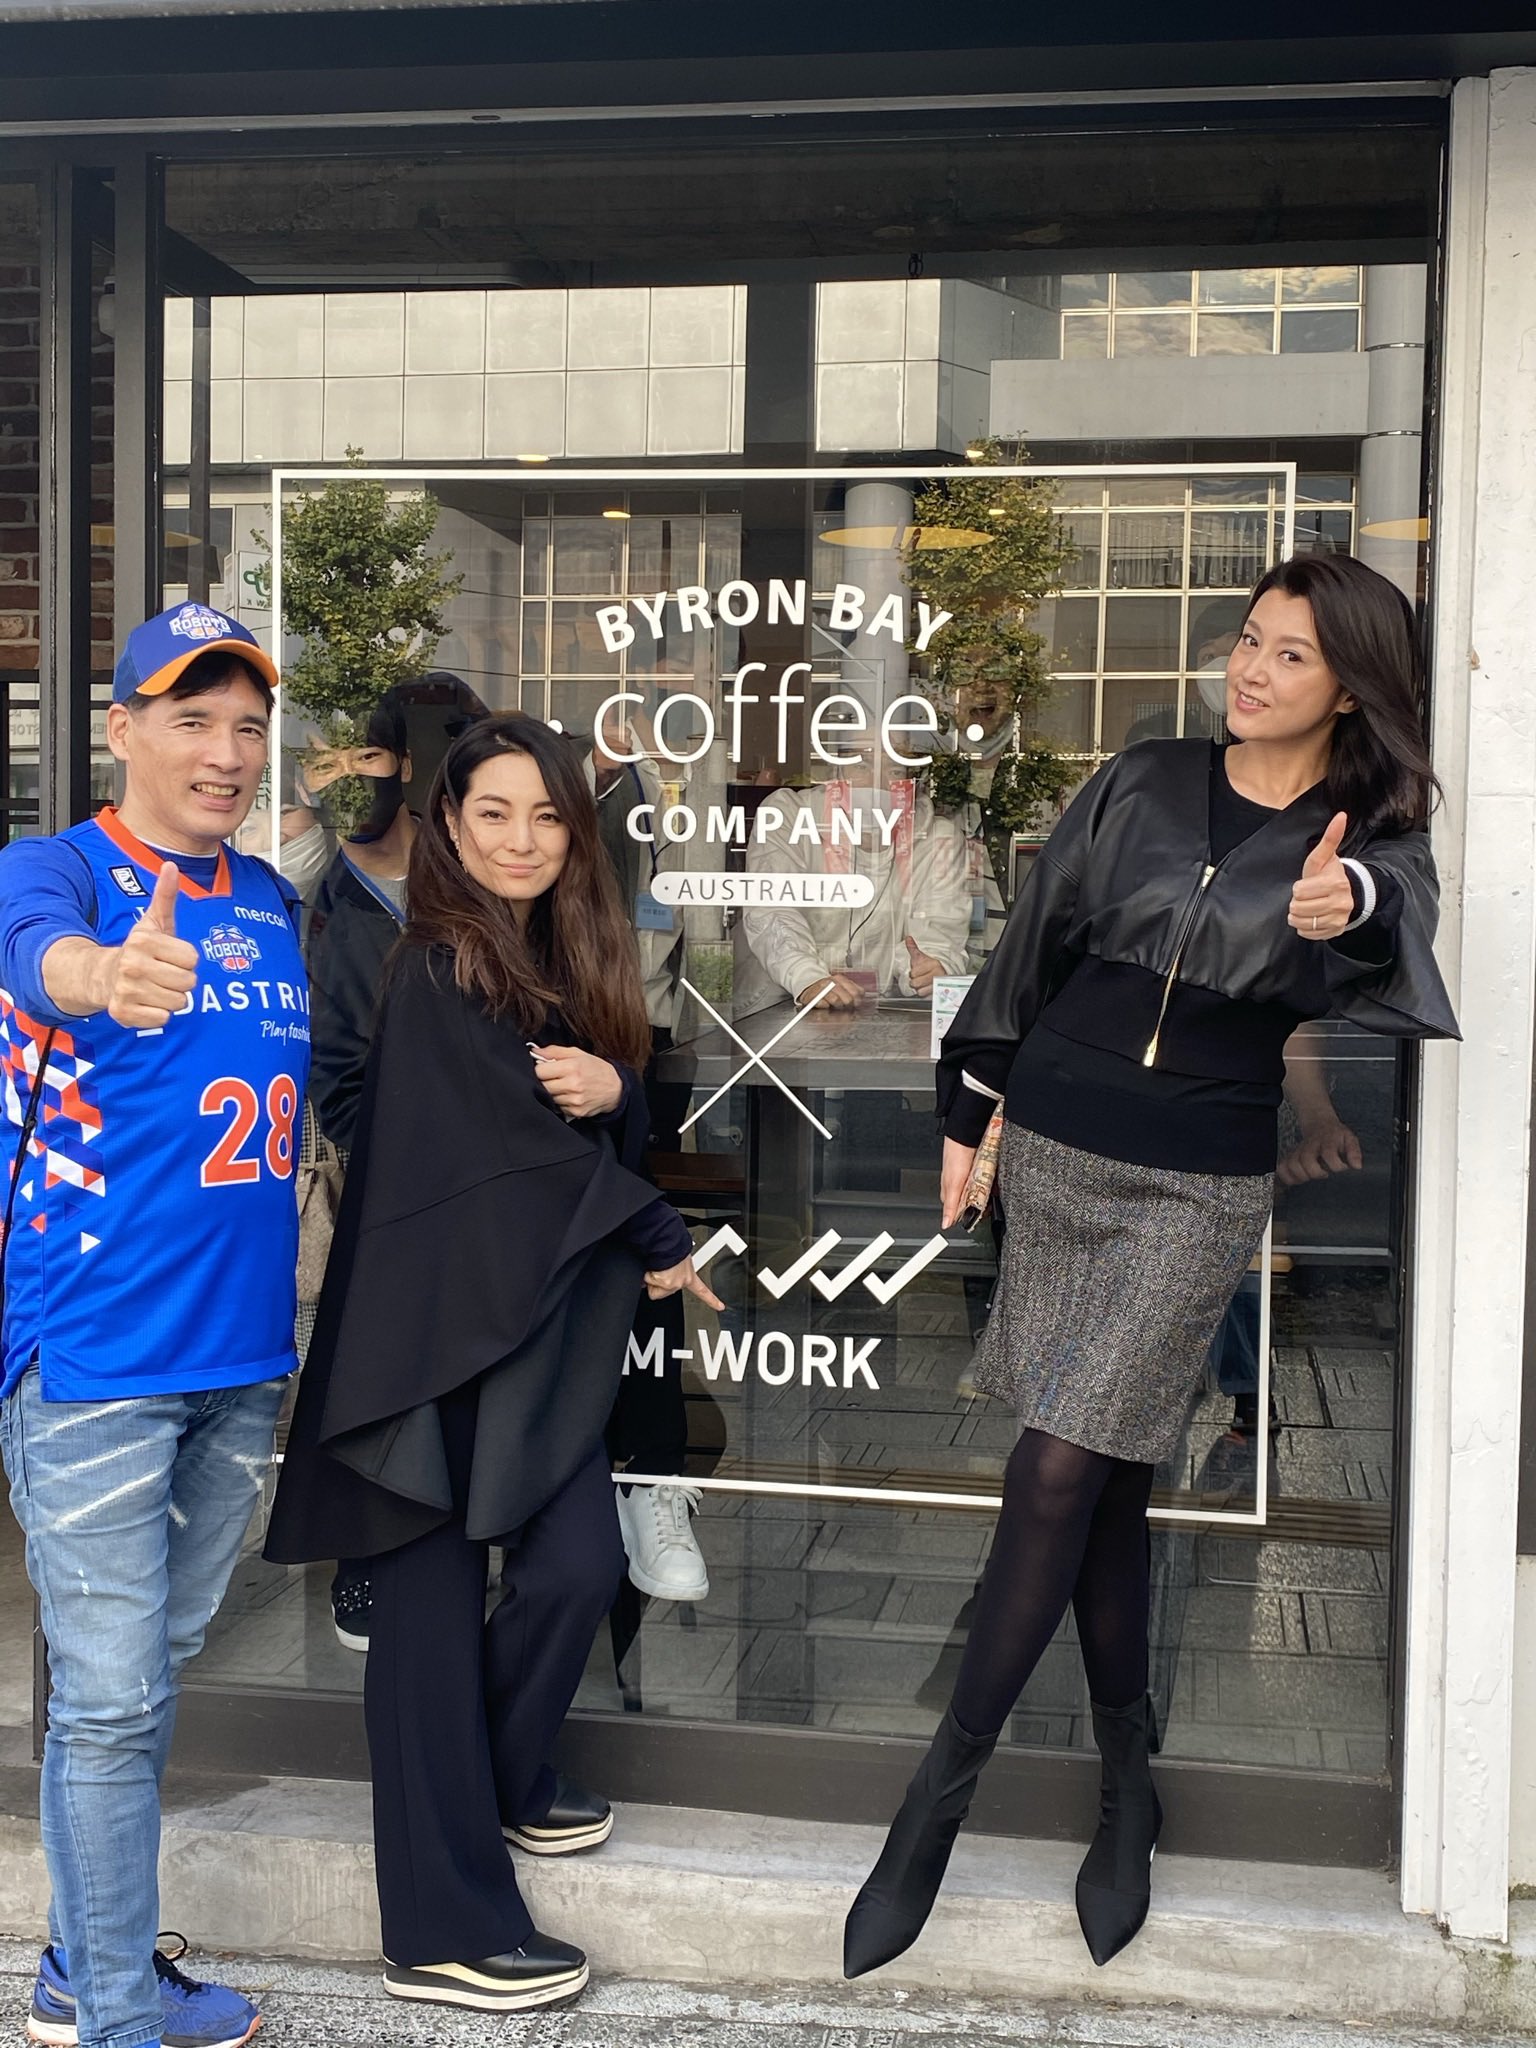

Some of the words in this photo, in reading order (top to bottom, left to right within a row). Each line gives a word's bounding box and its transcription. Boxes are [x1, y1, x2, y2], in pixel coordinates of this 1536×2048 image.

[171, 615, 231, 634] ROBOTS
[595, 578, 807, 654] BYRON
[828, 583, 953, 652] BAY
[593, 662, 938, 767] coffee
[626, 804, 904, 847] COMPANY
[677, 876, 848, 902] AUSTRALIA
[203, 937, 260, 960] ROBOTS
[259, 1020, 287, 1047] Play
[199, 1073, 297, 1188] 28
[622, 1326, 882, 1391] M-WORK
